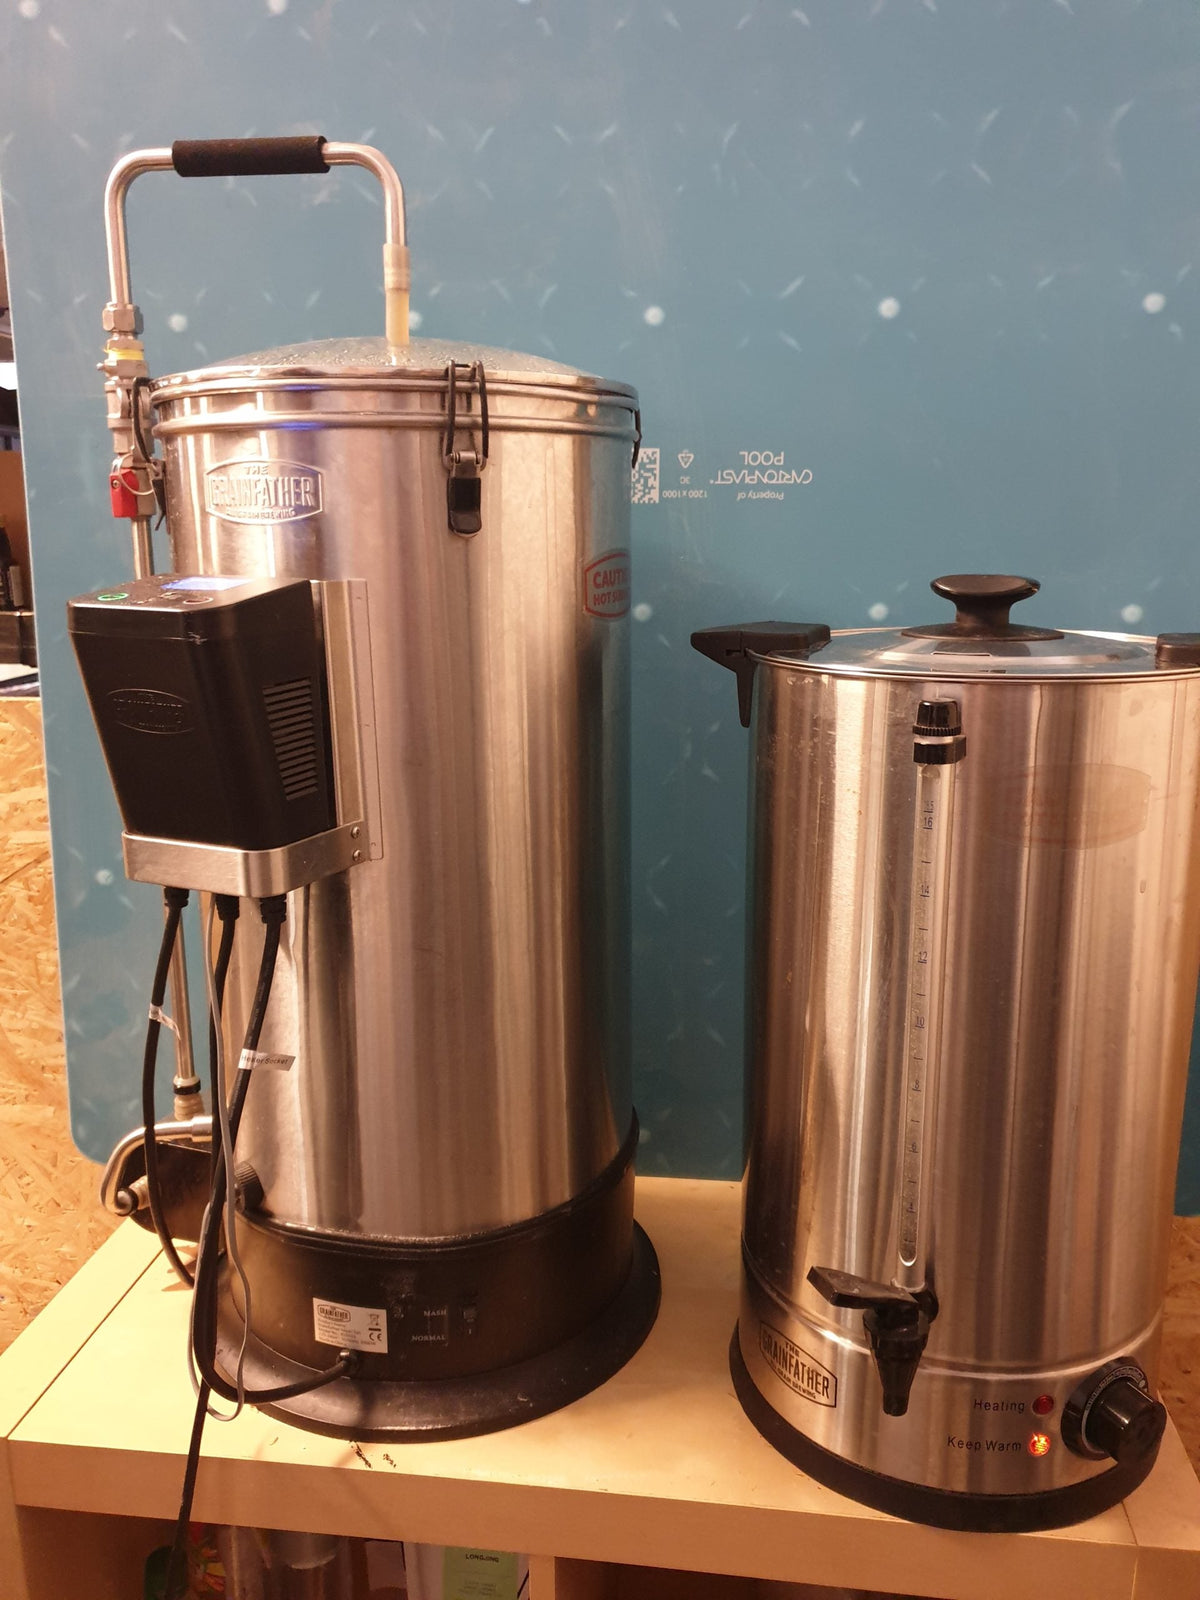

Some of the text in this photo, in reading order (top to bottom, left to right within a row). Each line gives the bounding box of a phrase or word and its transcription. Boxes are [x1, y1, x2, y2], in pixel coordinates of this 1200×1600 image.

[739, 451, 784, 465] POOL
[244, 465, 269, 475] THE
[662, 489, 681, 498] 1000
[688, 489, 708, 498] 1200
[736, 490, 784, 501] Property of
[592, 567, 626, 589] CAUT
[924, 816, 933, 827] 16
[918, 951, 928, 962] 12
[916, 1015, 925, 1026] 10
[785, 1341, 800, 1358] THE
[762, 1330, 830, 1400] GRAINFATHER
[973, 1399, 1026, 1414] Heating
[947, 1436, 1022, 1452] Keep Warm
